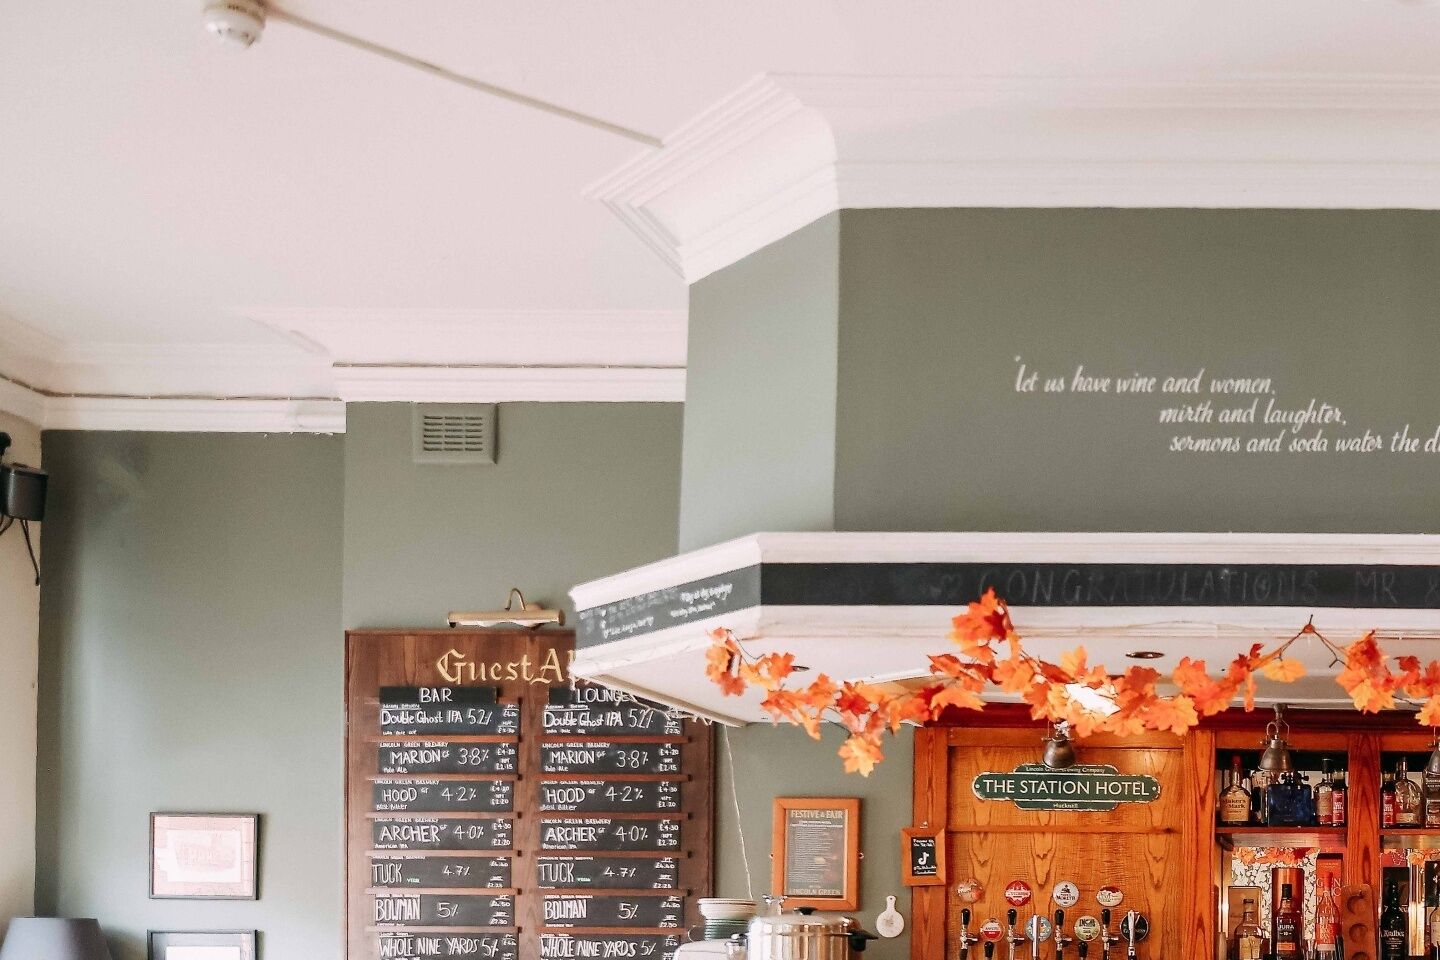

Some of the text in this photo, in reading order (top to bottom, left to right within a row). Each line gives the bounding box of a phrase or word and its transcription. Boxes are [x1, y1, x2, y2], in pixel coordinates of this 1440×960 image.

[1044, 376, 1065, 393] us
[1071, 365, 1111, 393] have
[1116, 373, 1157, 393] wine
[1162, 368, 1206, 393] and
[1159, 400, 1213, 423] mirth
[1218, 398, 1259, 423] and
[1169, 435, 1241, 452] sermons
[1246, 429, 1286, 452] and
[1289, 429, 1328, 452] soda
[1335, 429, 1382, 452] water
[1391, 424, 1417, 453] the
[436, 649, 533, 684] Guest
[421, 687, 453, 702] BAR
[381, 710, 415, 725] Double
[415, 711, 443, 724] Ghost
[447, 710, 463, 724] IPA
[543, 711, 577, 728] Double
[580, 711, 604, 727] Ghost
[606, 711, 623, 727] IPA
[391, 749, 440, 764] MARION
[551, 750, 595, 764] MARION
[383, 788, 417, 802] HOOD
[546, 787, 586, 804] HOOD
[983, 779, 1150, 796] THE STATION HOTEL
[380, 825, 441, 843] ARCHER
[545, 827, 598, 842] ARCHER
[372, 863, 402, 883] TUCK
[537, 862, 575, 882] TUCK
[375, 898, 421, 921] BOWMAN
[544, 899, 587, 919] BOWMAN
[379, 938, 415, 957] WHOLE
[417, 937, 442, 955] NINE
[446, 937, 480, 955] YARDS
[540, 937, 575, 957] WHOLE
[576, 940, 602, 957] NINE
[602, 940, 639, 958] YARDS
